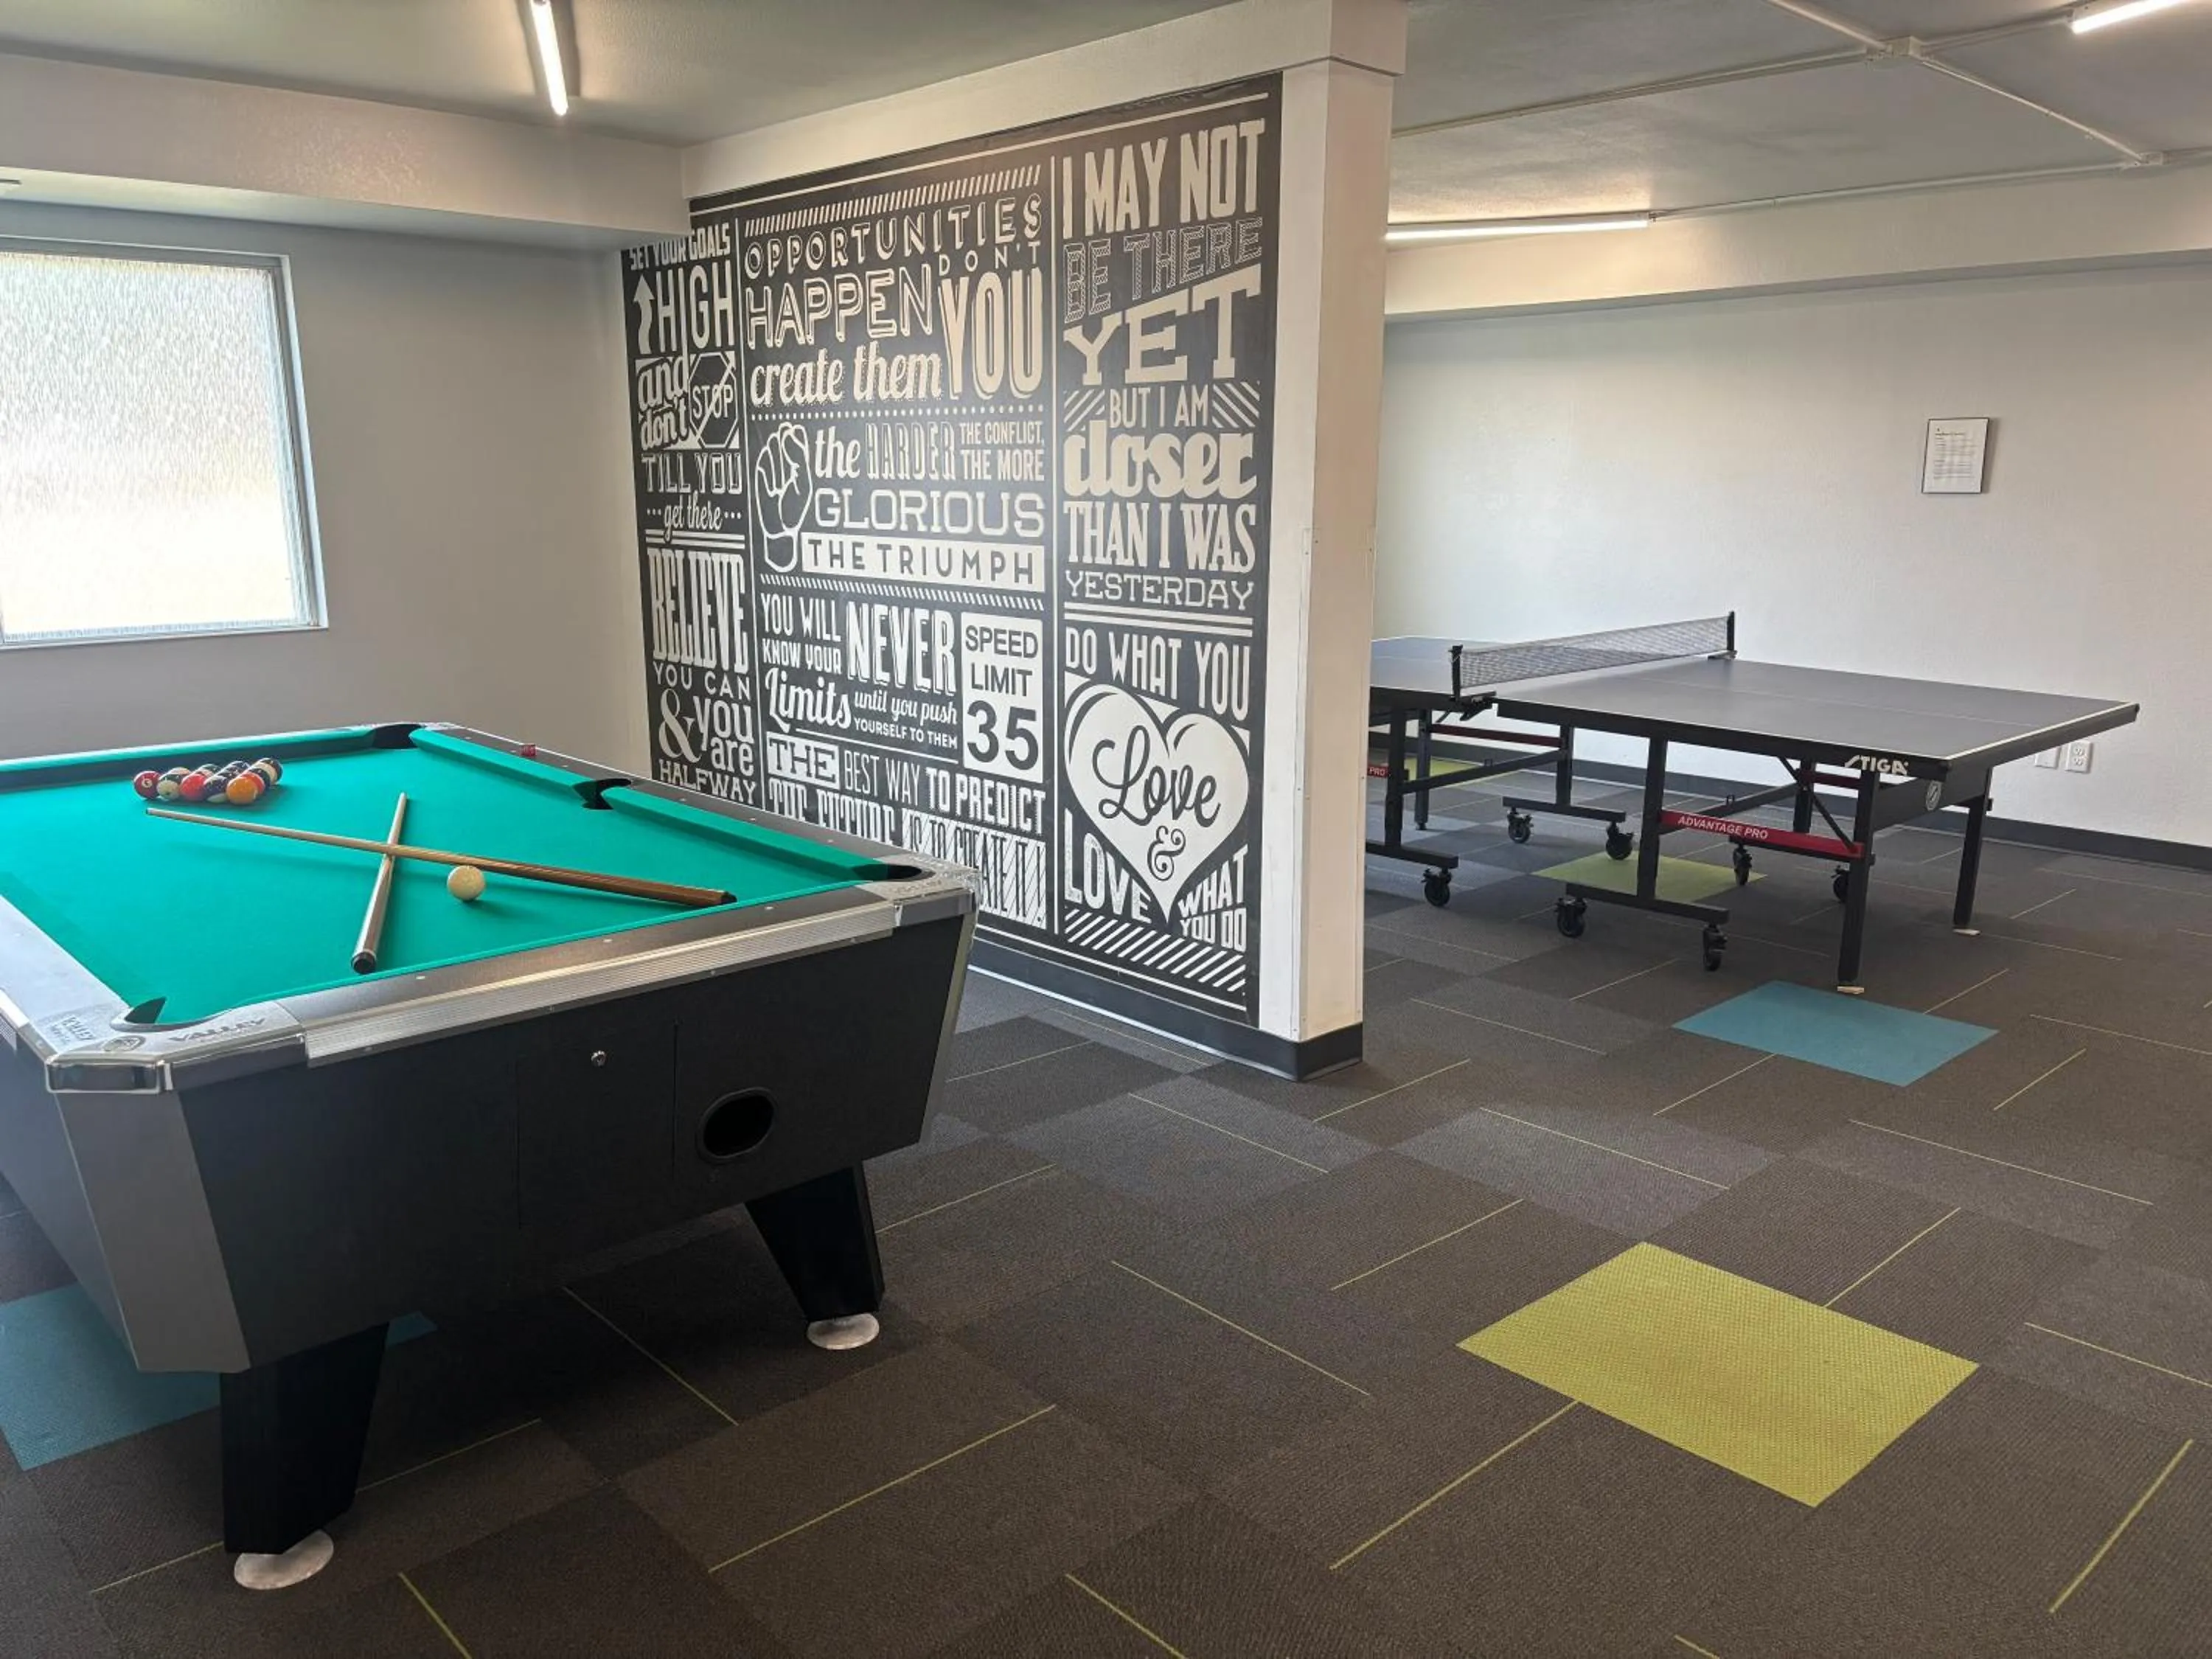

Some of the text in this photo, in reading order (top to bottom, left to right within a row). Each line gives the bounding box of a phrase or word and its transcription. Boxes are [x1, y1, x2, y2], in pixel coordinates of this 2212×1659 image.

[1063, 118, 1265, 239] I MAY NOT
[653, 235, 687, 266] YOUR
[689, 223, 731, 260] GOALS
[744, 193, 1042, 279] OPPORTUNITIES
[939, 240, 1041, 276] DON'T
[1063, 216, 1263, 324] BE THERE
[655, 259, 735, 352] HIGH
[745, 263, 933, 351] HAPPEN
[1063, 263, 1262, 385] YET
[937, 266, 1043, 400] YOU
[639, 355, 689, 411] and
[750, 340, 942, 407] create them
[641, 397, 687, 451] don't
[693, 384, 734, 419] STOP
[1110, 384, 1208, 428] BUT I AM
[814, 421, 957, 481] the HARDER
[959, 422, 981, 445] THE
[1063, 420, 1257, 499] closer
[641, 452, 742, 494] TILL YOU
[960, 448, 1045, 482] THE MORE
[814, 487, 1046, 538] GLORIOUS
[1063, 501, 1256, 574] THAN I WAS
[808, 539, 1034, 585] THE TRIUMPH
[647, 547, 749, 674] BELIEVE
[1065, 570, 1254, 611] YESTERDAY
[761, 593, 841, 643] YOU WILL
[965, 625, 1039, 659] SPEED
[762, 638, 843, 675] KNOW YOUR
[846, 601, 957, 696] NEVER
[1066, 626, 1251, 722] DO WHAT YOU
[653, 661, 751, 700] YOU CAN
[764, 667, 852, 734] Limits
[971, 662, 1033, 697] LIMIT
[658, 688, 754, 763] & you
[854, 717, 958, 750] YOURSELF TO THEM
[855, 690, 958, 727] until you push
[967, 700, 1040, 771] 35
[659, 759, 757, 804] HALFWAY
[710, 737, 754, 776] are
[1092, 725, 1222, 827] Love
[1844, 754, 1908, 776] STIGA
[768, 737, 1046, 835] THE BEST WAY TO PREDICT
[1147, 825, 1186, 881] &
[1677, 815, 1768, 840] ADVANTAGE PRO
[1064, 807, 1248, 923] LOVE WHAT
[1180, 908, 1247, 953] YOU DO
